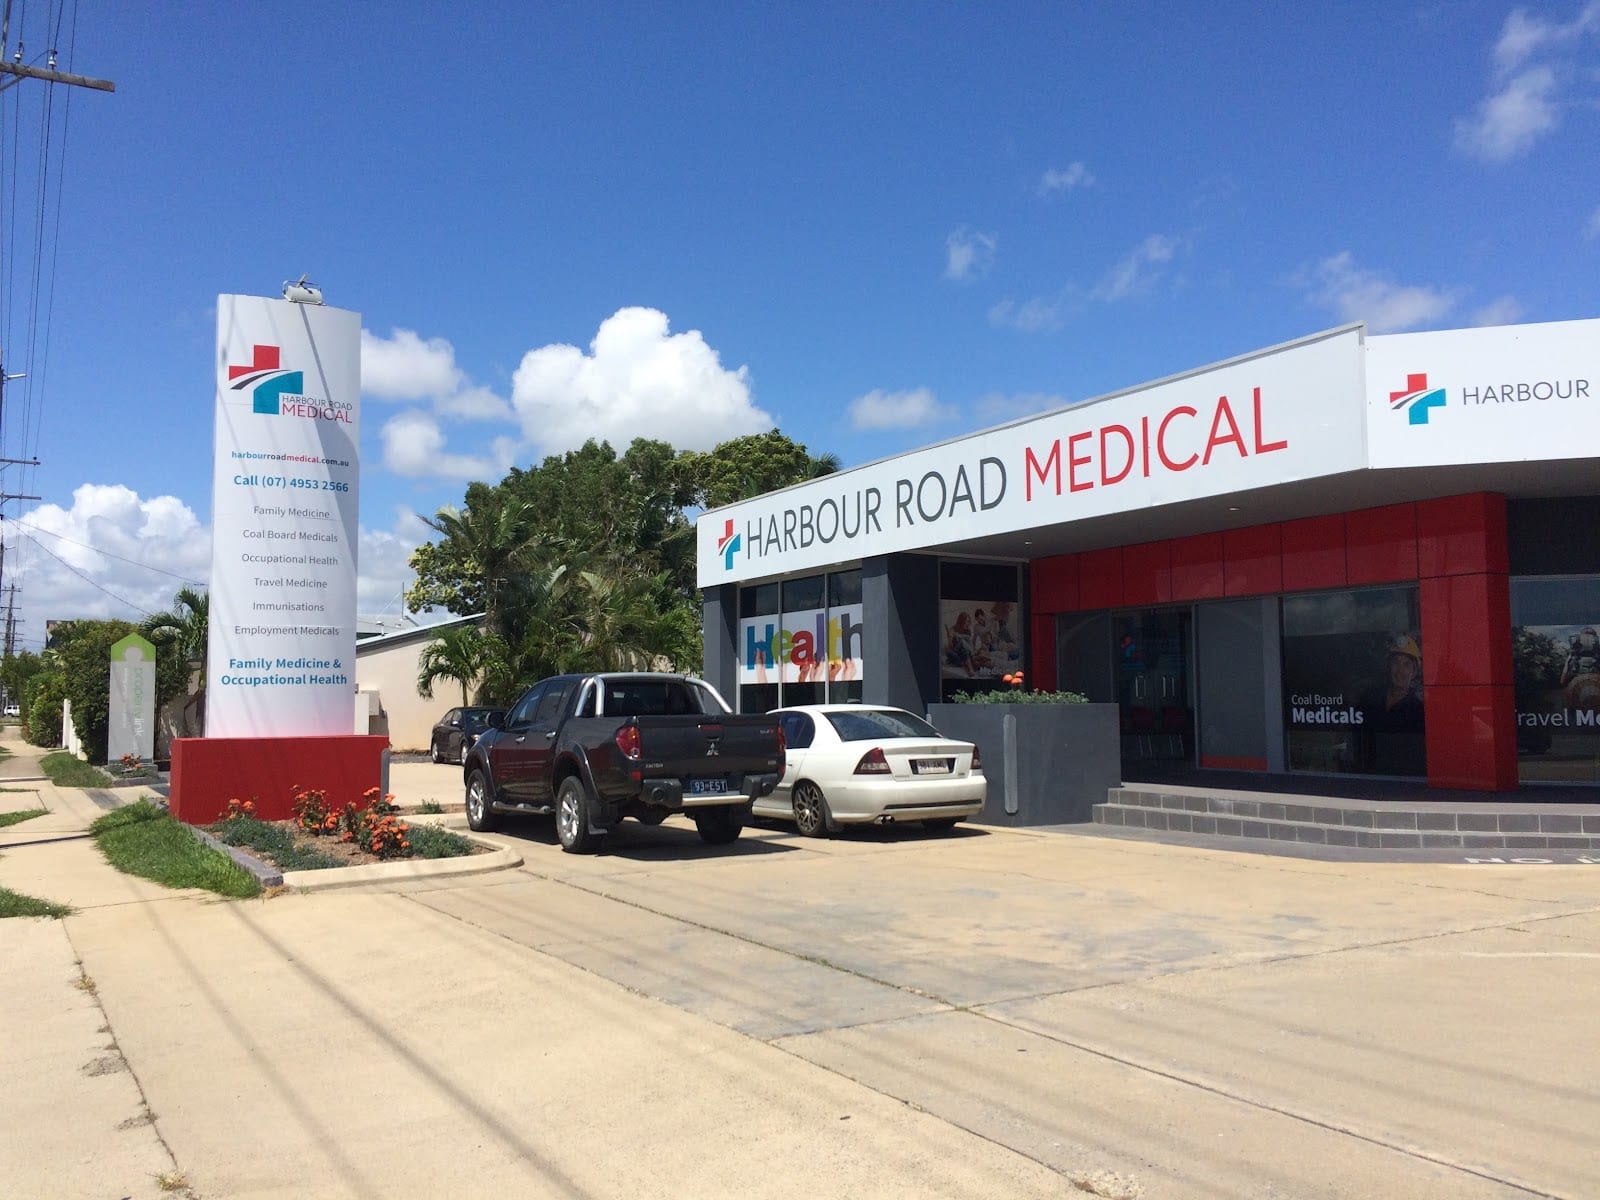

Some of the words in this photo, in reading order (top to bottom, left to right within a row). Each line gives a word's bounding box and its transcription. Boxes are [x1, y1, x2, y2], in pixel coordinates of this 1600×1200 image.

[1463, 379, 1590, 405] HARBOUR
[282, 395, 326, 407] HARBOUR
[328, 400, 353, 411] ROAD
[282, 403, 353, 424] MEDICAL
[231, 451, 349, 467] harbourroadmedical.com.au
[747, 487, 883, 560] HARBOUR
[896, 456, 1007, 528] ROAD
[1025, 387, 1288, 502] MEDICAL
[233, 475, 258, 486] Call
[262, 475, 286, 489] (07)
[290, 478, 319, 489] 4953
[322, 481, 349, 493] 2566
[253, 506, 286, 518] Family
[288, 507, 330, 519] Medicine
[243, 529, 265, 539] Coal
[267, 530, 296, 540] Board
[299, 532, 338, 542] Medicals
[241, 553, 307, 565] Occupational
[309, 555, 339, 566] Health
[254, 577, 284, 587] Travel
[286, 578, 328, 589] Medicine
[252, 601, 325, 612] Immunisations
[234, 625, 298, 637] Employment
[300, 626, 340, 636] Medicals
[747, 613, 863, 670] Health
[229, 658, 272, 671] Family
[276, 658, 330, 669] Medicine
[332, 658, 342, 668] &
[221, 674, 306, 687] Occupational
[309, 674, 347, 685] Health
[1291, 693, 1312, 705] Coal
[1314, 693, 1343, 705] Board
[1292, 706, 1364, 725] Medicals
[1515, 708, 1570, 727] ravel
